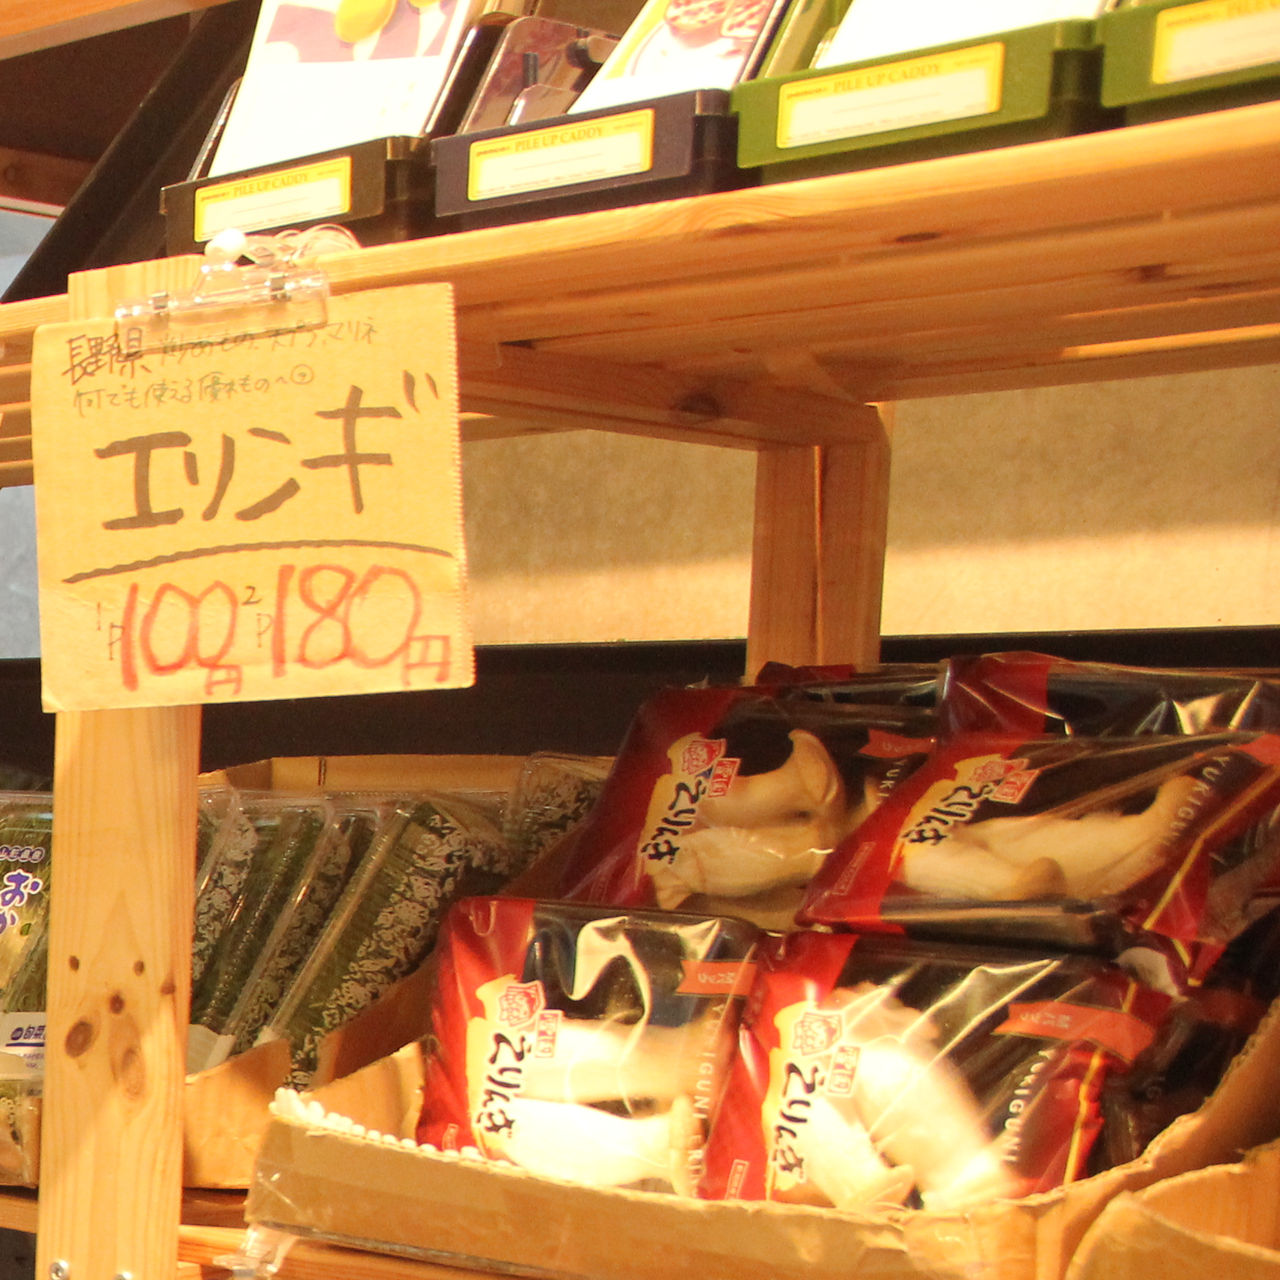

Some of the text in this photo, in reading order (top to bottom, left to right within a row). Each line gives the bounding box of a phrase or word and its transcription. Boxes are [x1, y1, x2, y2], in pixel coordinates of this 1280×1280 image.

[887, 62, 941, 85] CADDY
[515, 139, 539, 153] PILE
[560, 126, 604, 146] CADDY
[233, 182, 257, 198] PILE
[271, 172, 309, 191] CADDY
[62, 318, 153, 385] 長野県
[94, 369, 440, 531] エリンギ
[641, 776, 710, 865] えりんぎ
[476, 1031, 533, 1140] えりんぎ
[773, 1061, 824, 1175] えりんぎ
